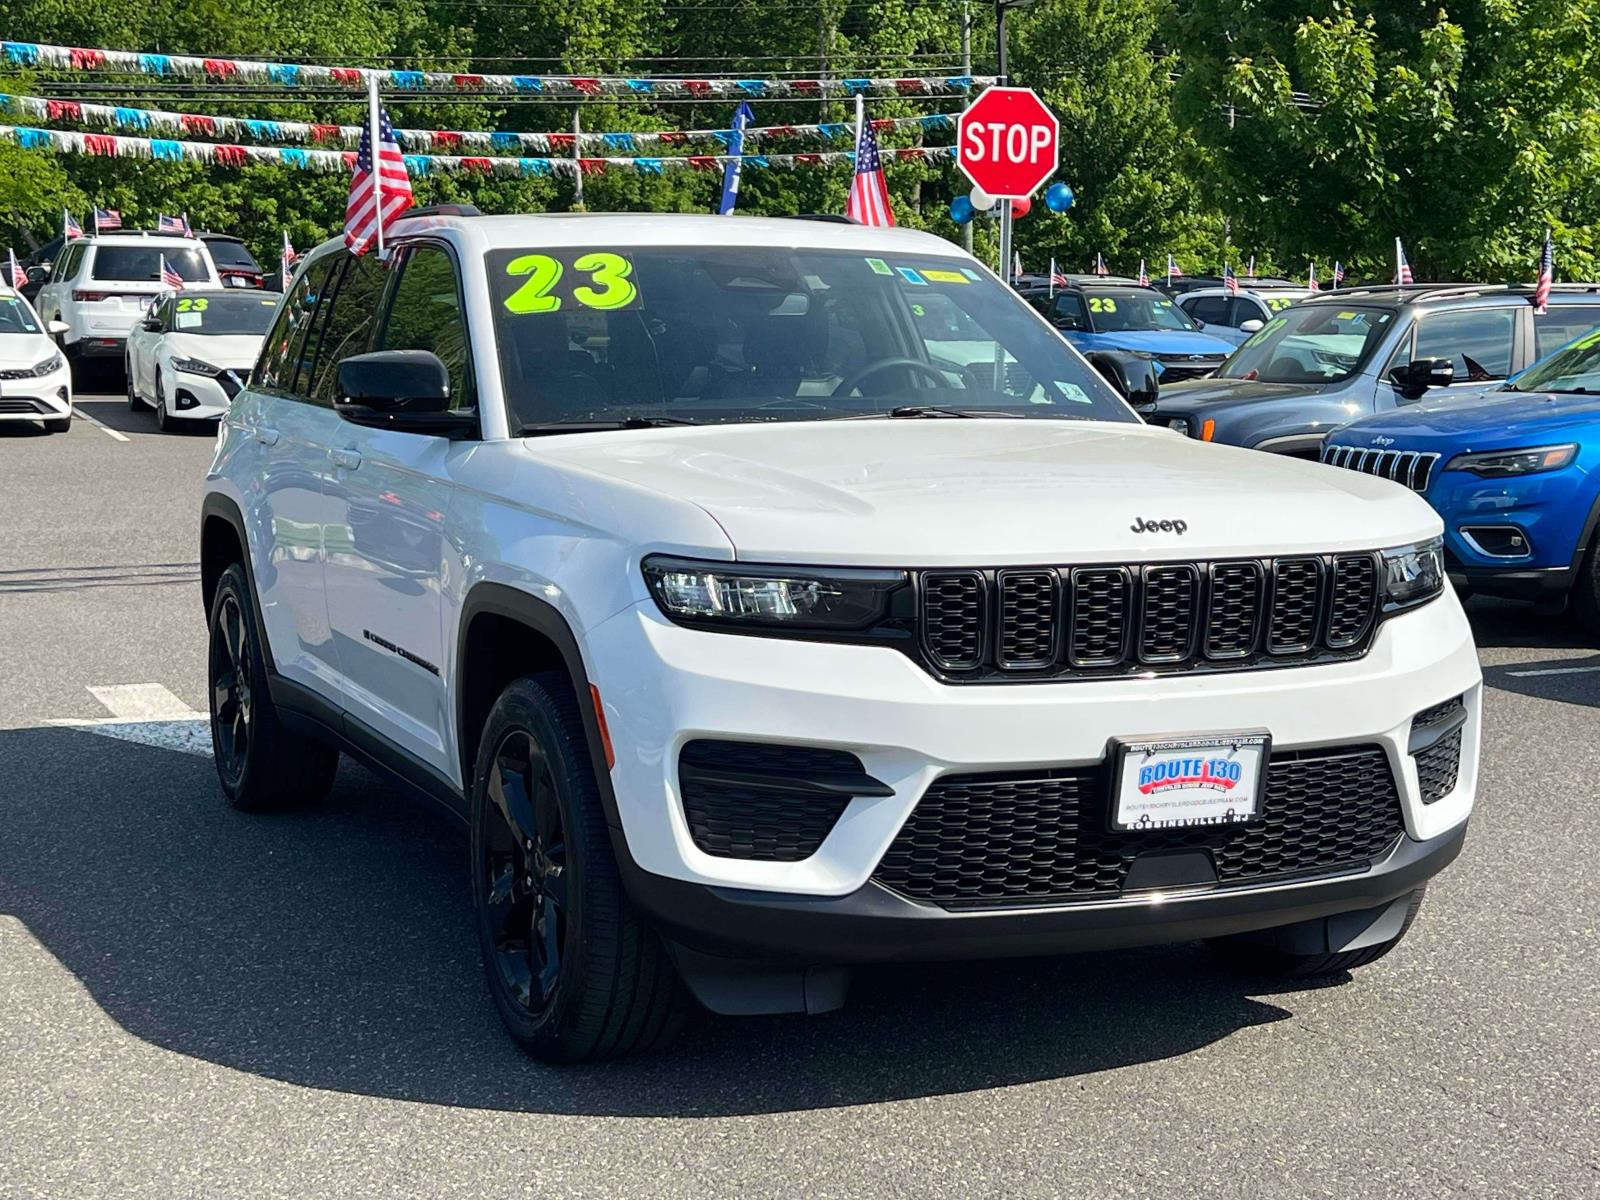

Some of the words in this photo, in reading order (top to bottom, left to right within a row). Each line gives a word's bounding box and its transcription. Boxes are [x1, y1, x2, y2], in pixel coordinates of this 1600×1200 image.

[964, 121, 1052, 164] STOP
[503, 252, 637, 315] 23
[176, 298, 209, 312] 23
[1089, 298, 1118, 313] 23
[1130, 516, 1188, 536] Jeep
[1138, 759, 1204, 786] ROUTE
[1208, 758, 1242, 782] 130
[1232, 814, 1249, 822] NJ
